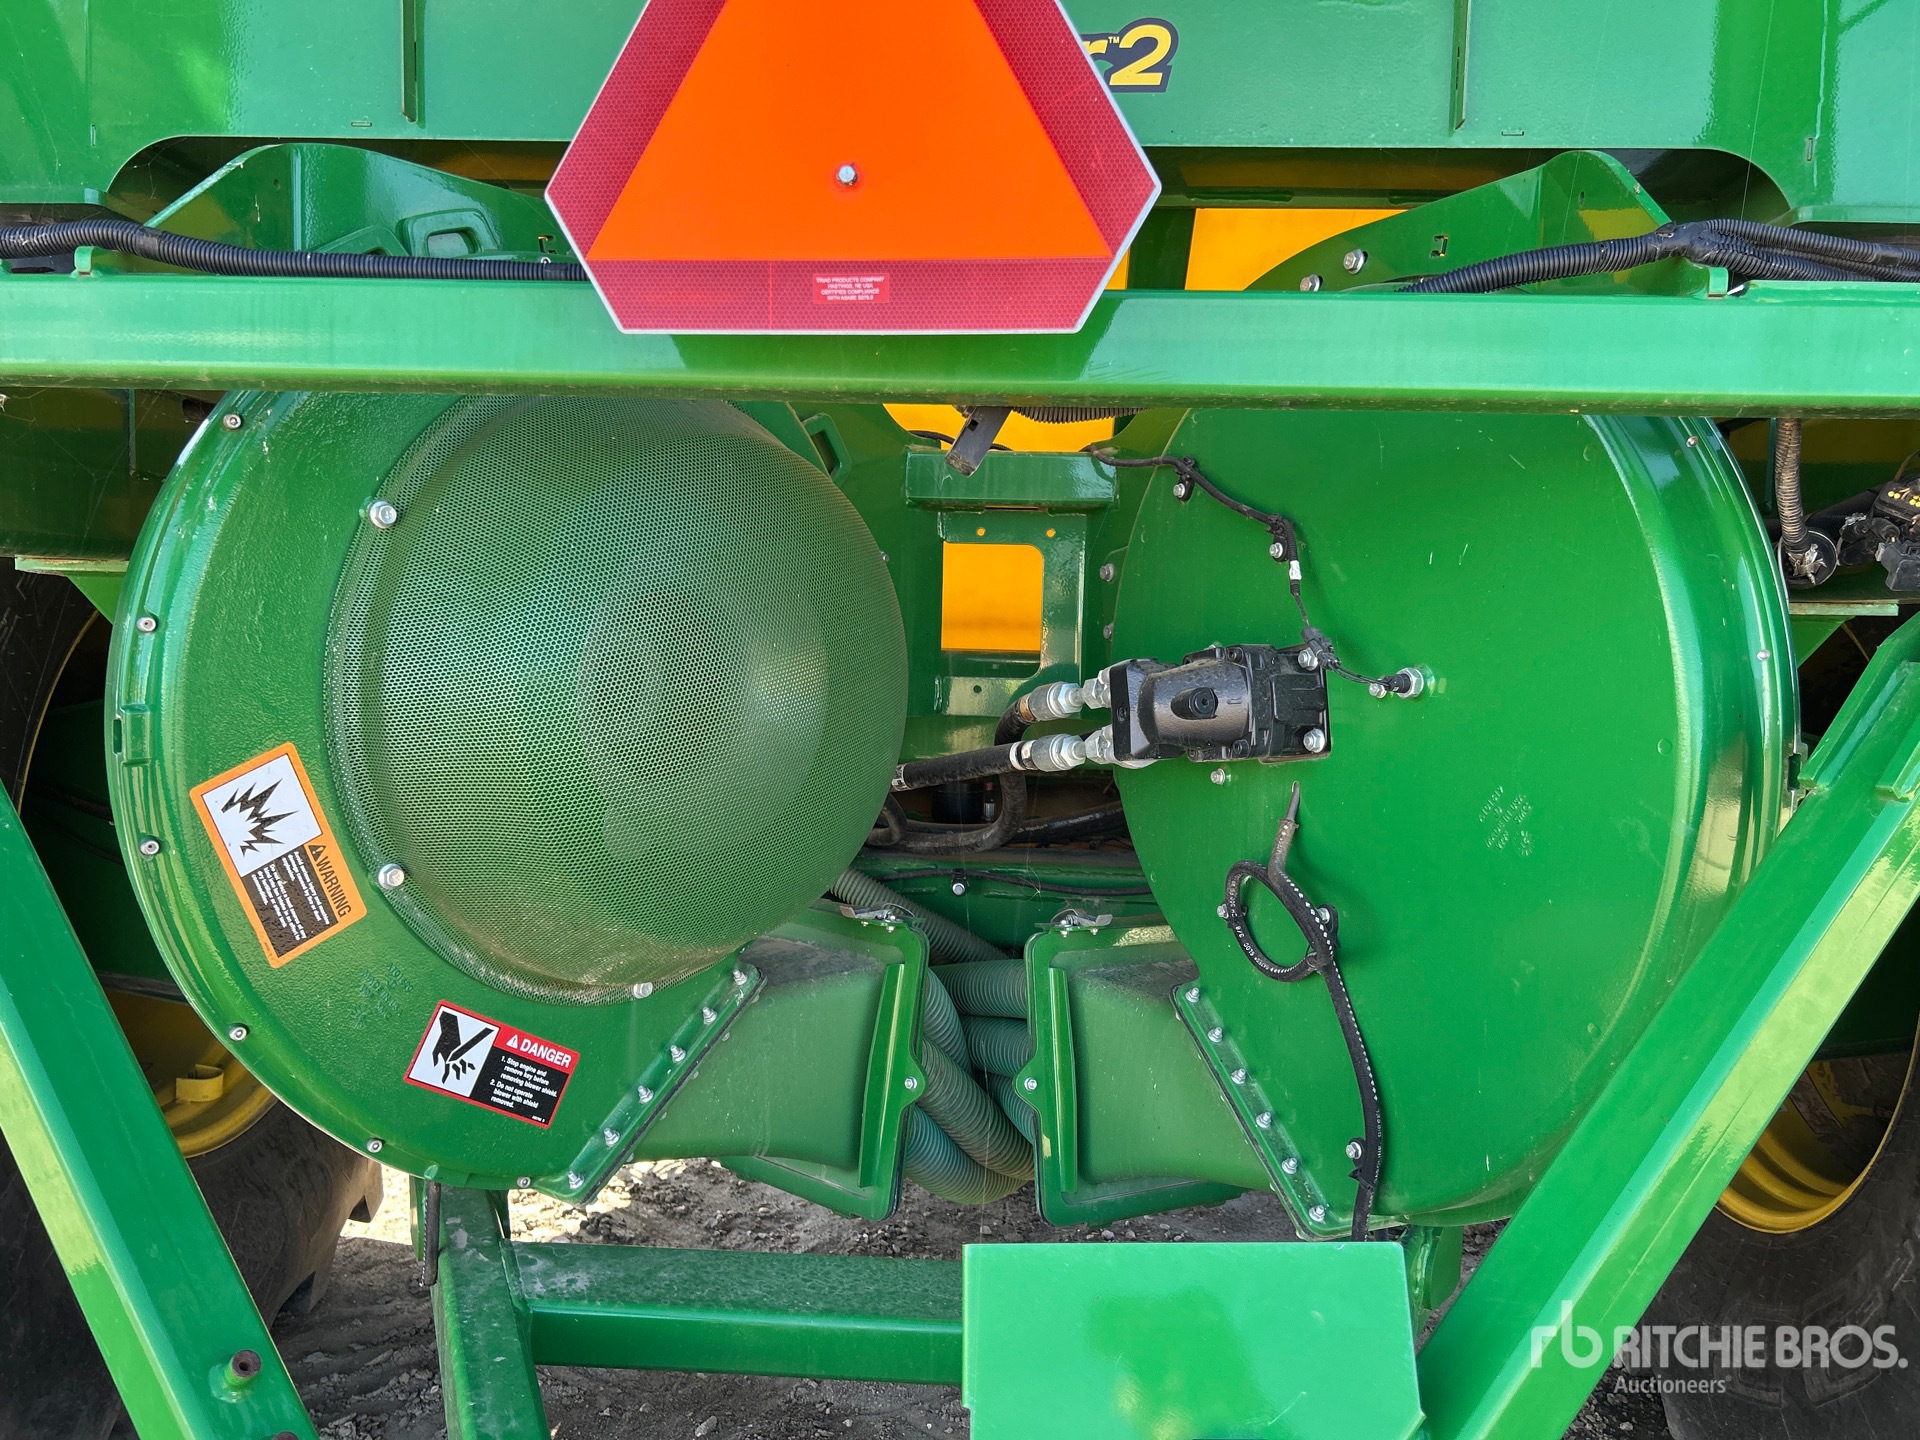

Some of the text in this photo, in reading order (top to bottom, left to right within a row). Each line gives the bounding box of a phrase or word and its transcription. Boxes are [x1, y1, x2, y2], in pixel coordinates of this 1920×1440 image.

[300, 865, 310, 882] serious
[308, 882, 317, 896] injury
[314, 896, 322, 905] and
[318, 905, 330, 924] machine
[317, 856, 351, 918] WARNING
[520, 1039, 572, 1068] DANGER
[504, 1065, 549, 1085] remove key before
[506, 1057, 519, 1067] Stop
[519, 1063, 536, 1073] engine
[496, 1080, 504, 1088] Do
[514, 1088, 533, 1098] operate
[500, 1073, 557, 1097] removing blower shield.
[490, 1096, 513, 1108] removed.
[493, 1088, 511, 1098] blower
[522, 1099, 538, 1108] shield
